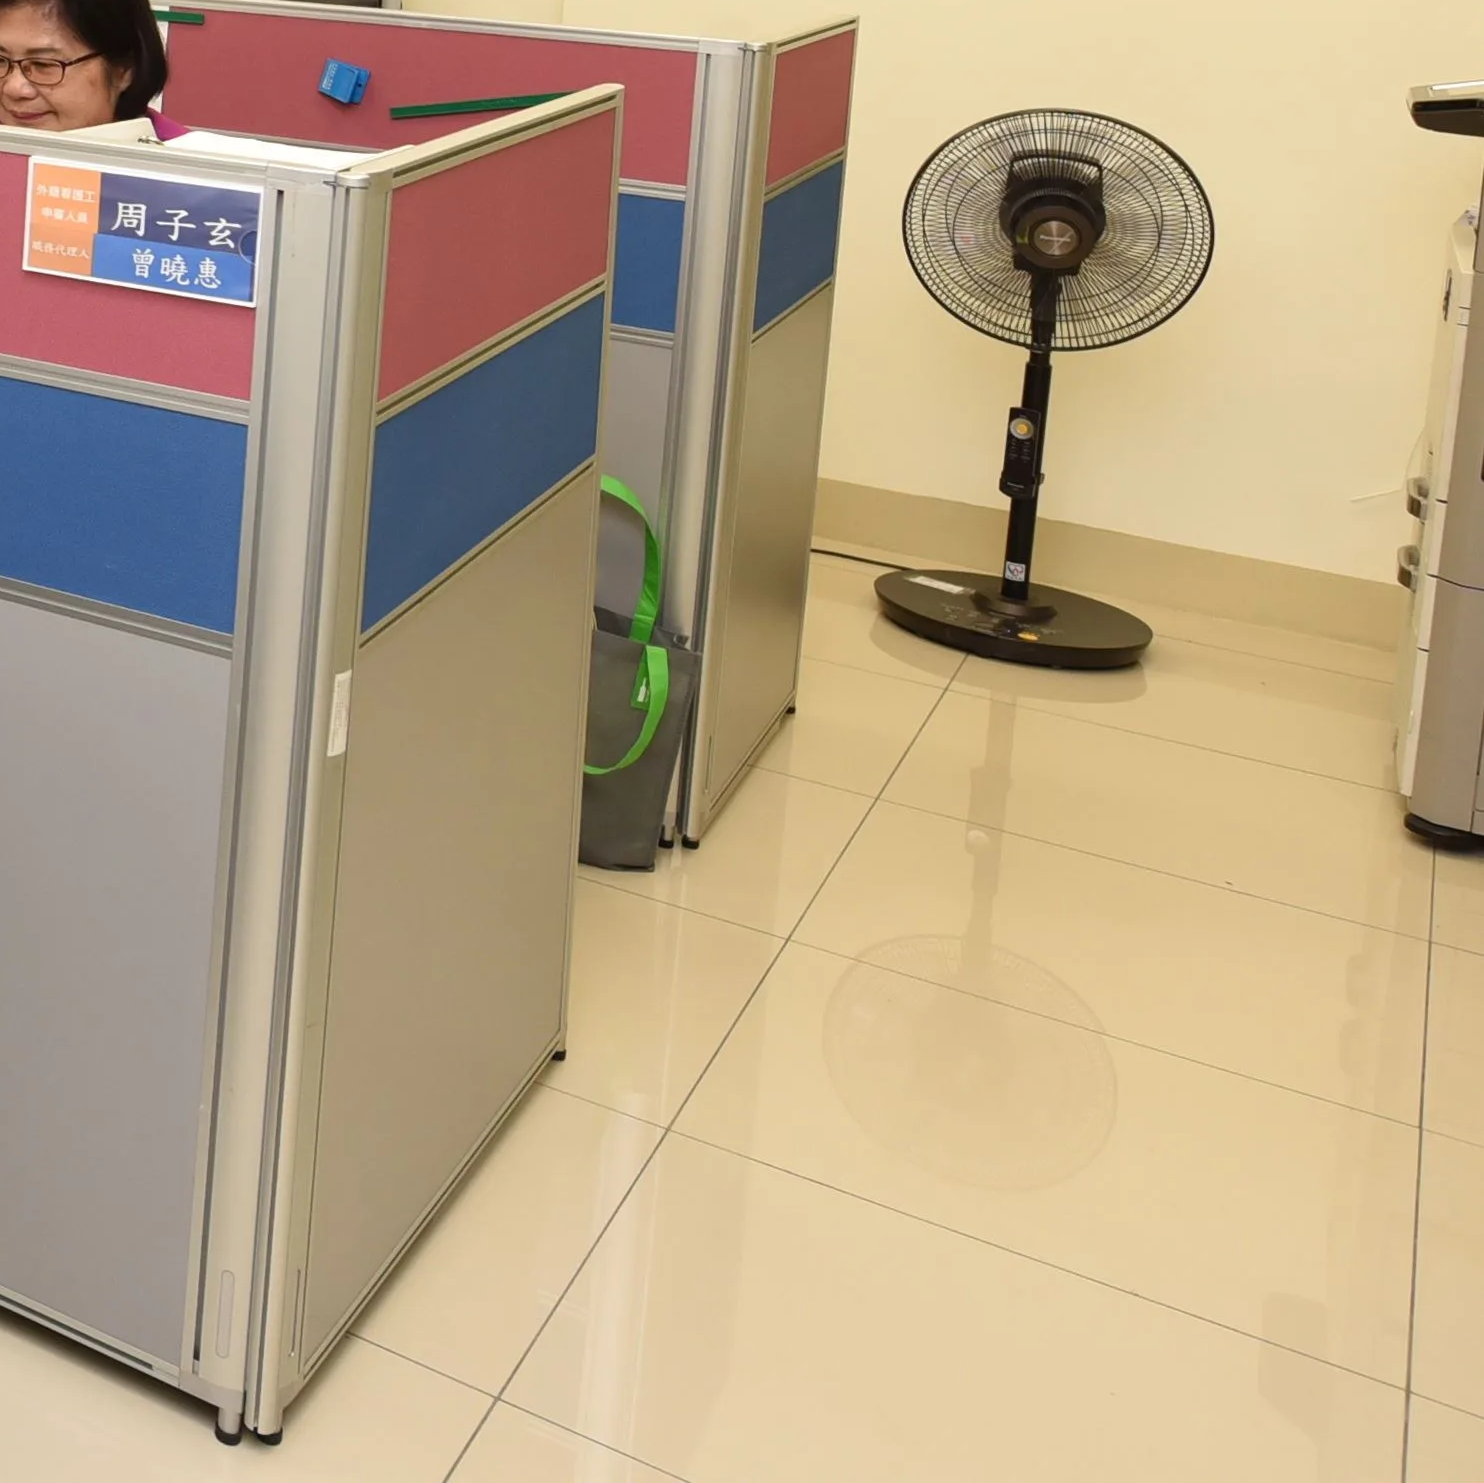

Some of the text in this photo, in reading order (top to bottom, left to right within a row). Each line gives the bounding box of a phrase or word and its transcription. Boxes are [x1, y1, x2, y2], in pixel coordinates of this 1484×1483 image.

[111, 201, 242, 249] 周子玄
[131, 248, 222, 290] 曾曉惠
